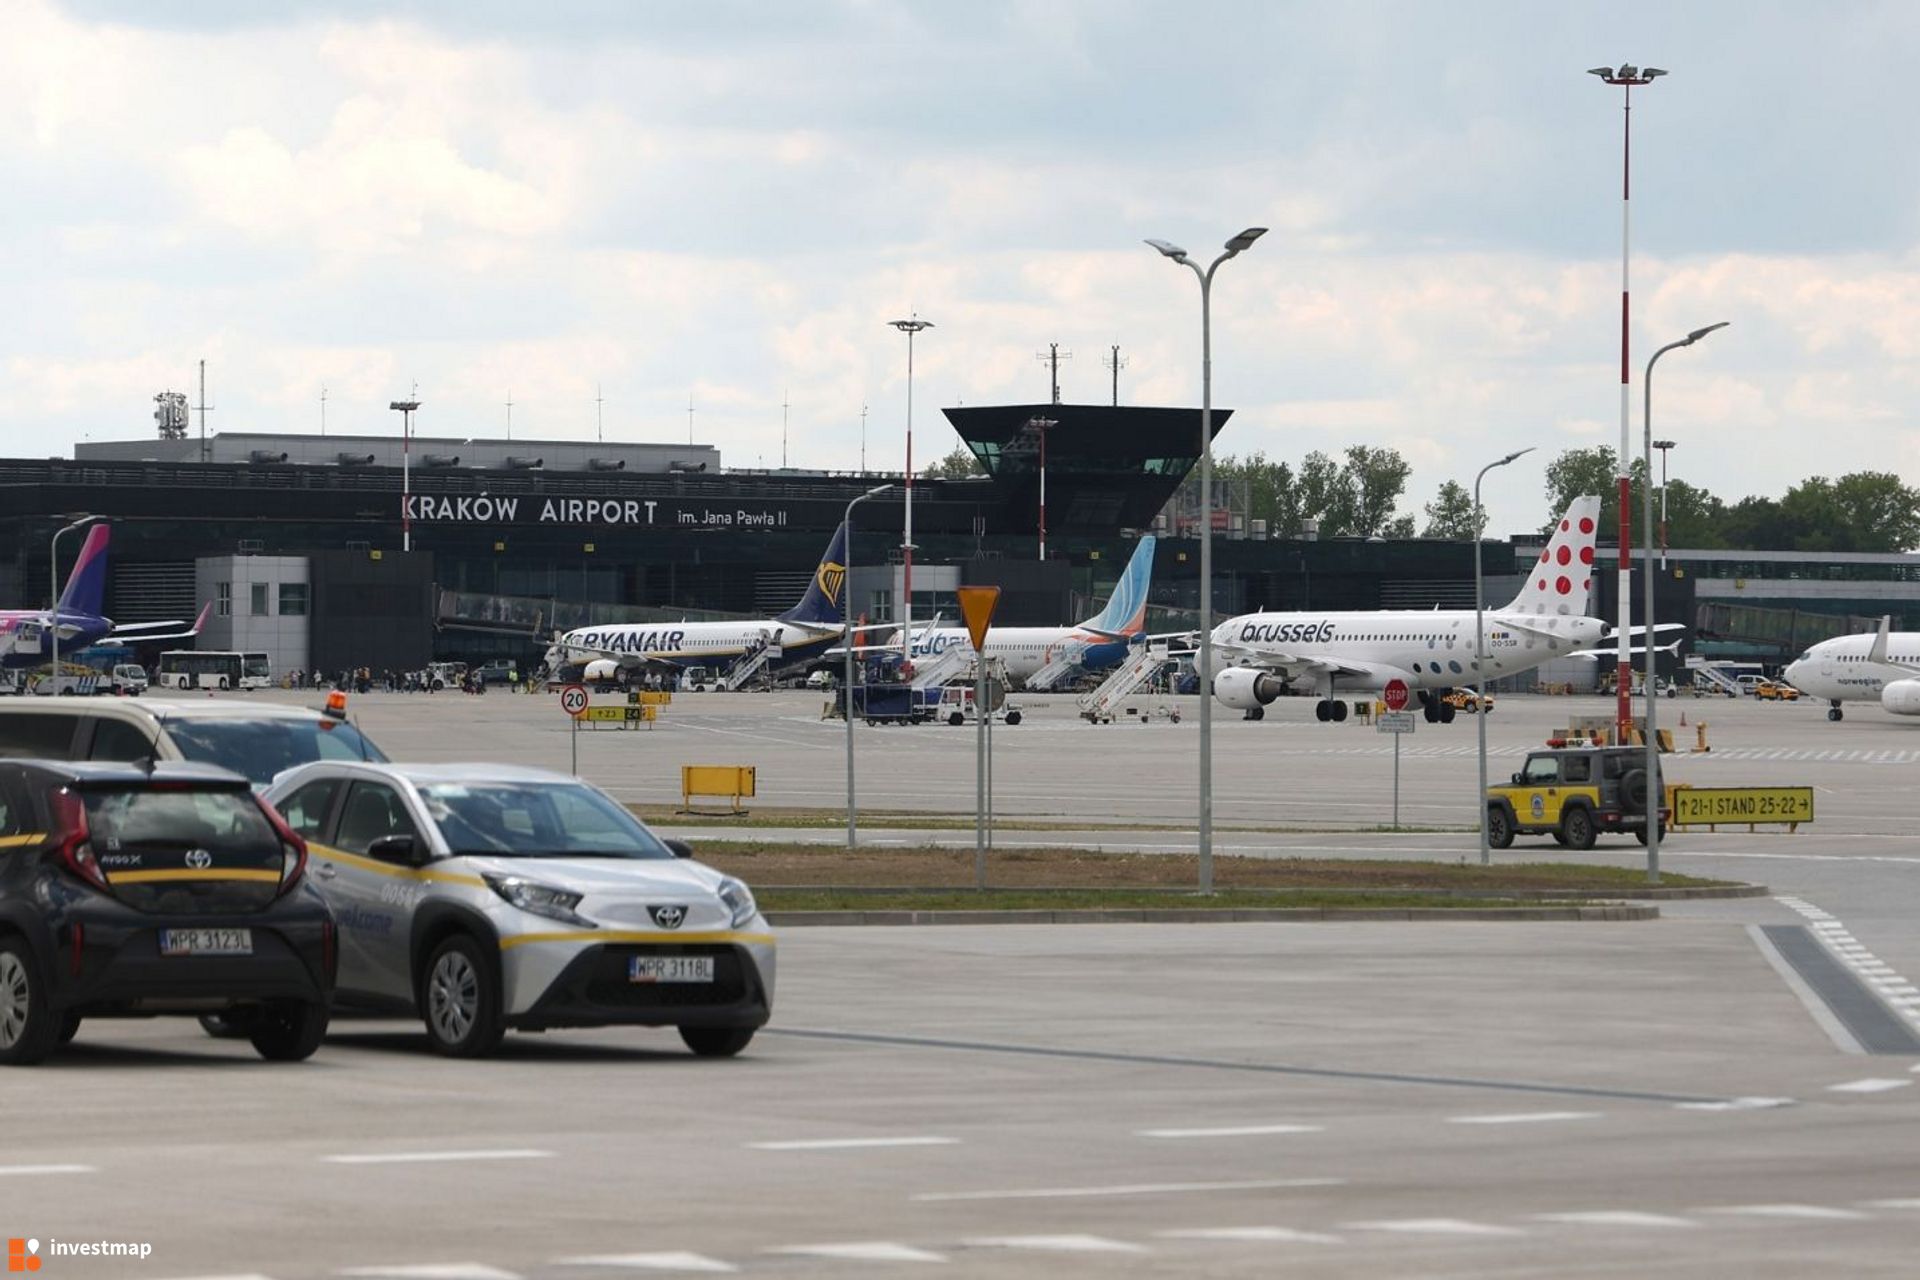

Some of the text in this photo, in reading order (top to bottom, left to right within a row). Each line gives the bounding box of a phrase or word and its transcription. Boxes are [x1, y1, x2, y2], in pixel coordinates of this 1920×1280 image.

[402, 492, 519, 521] KRAKÓW
[540, 500, 658, 524] AIRPORT
[678, 510, 698, 524] im.
[702, 509, 732, 525] Jana
[737, 510, 775, 525] Pawła
[1240, 619, 1336, 643] brussels
[583, 631, 685, 652] RYANAIR
[566, 693, 585, 707] 20
[1386, 689, 1407, 701] STOP
[1690, 796, 1796, 815] 21-1 STAND 25-22
[167, 929, 251, 950] WPR 3123L
[637, 958, 711, 978] WPR 3118L
